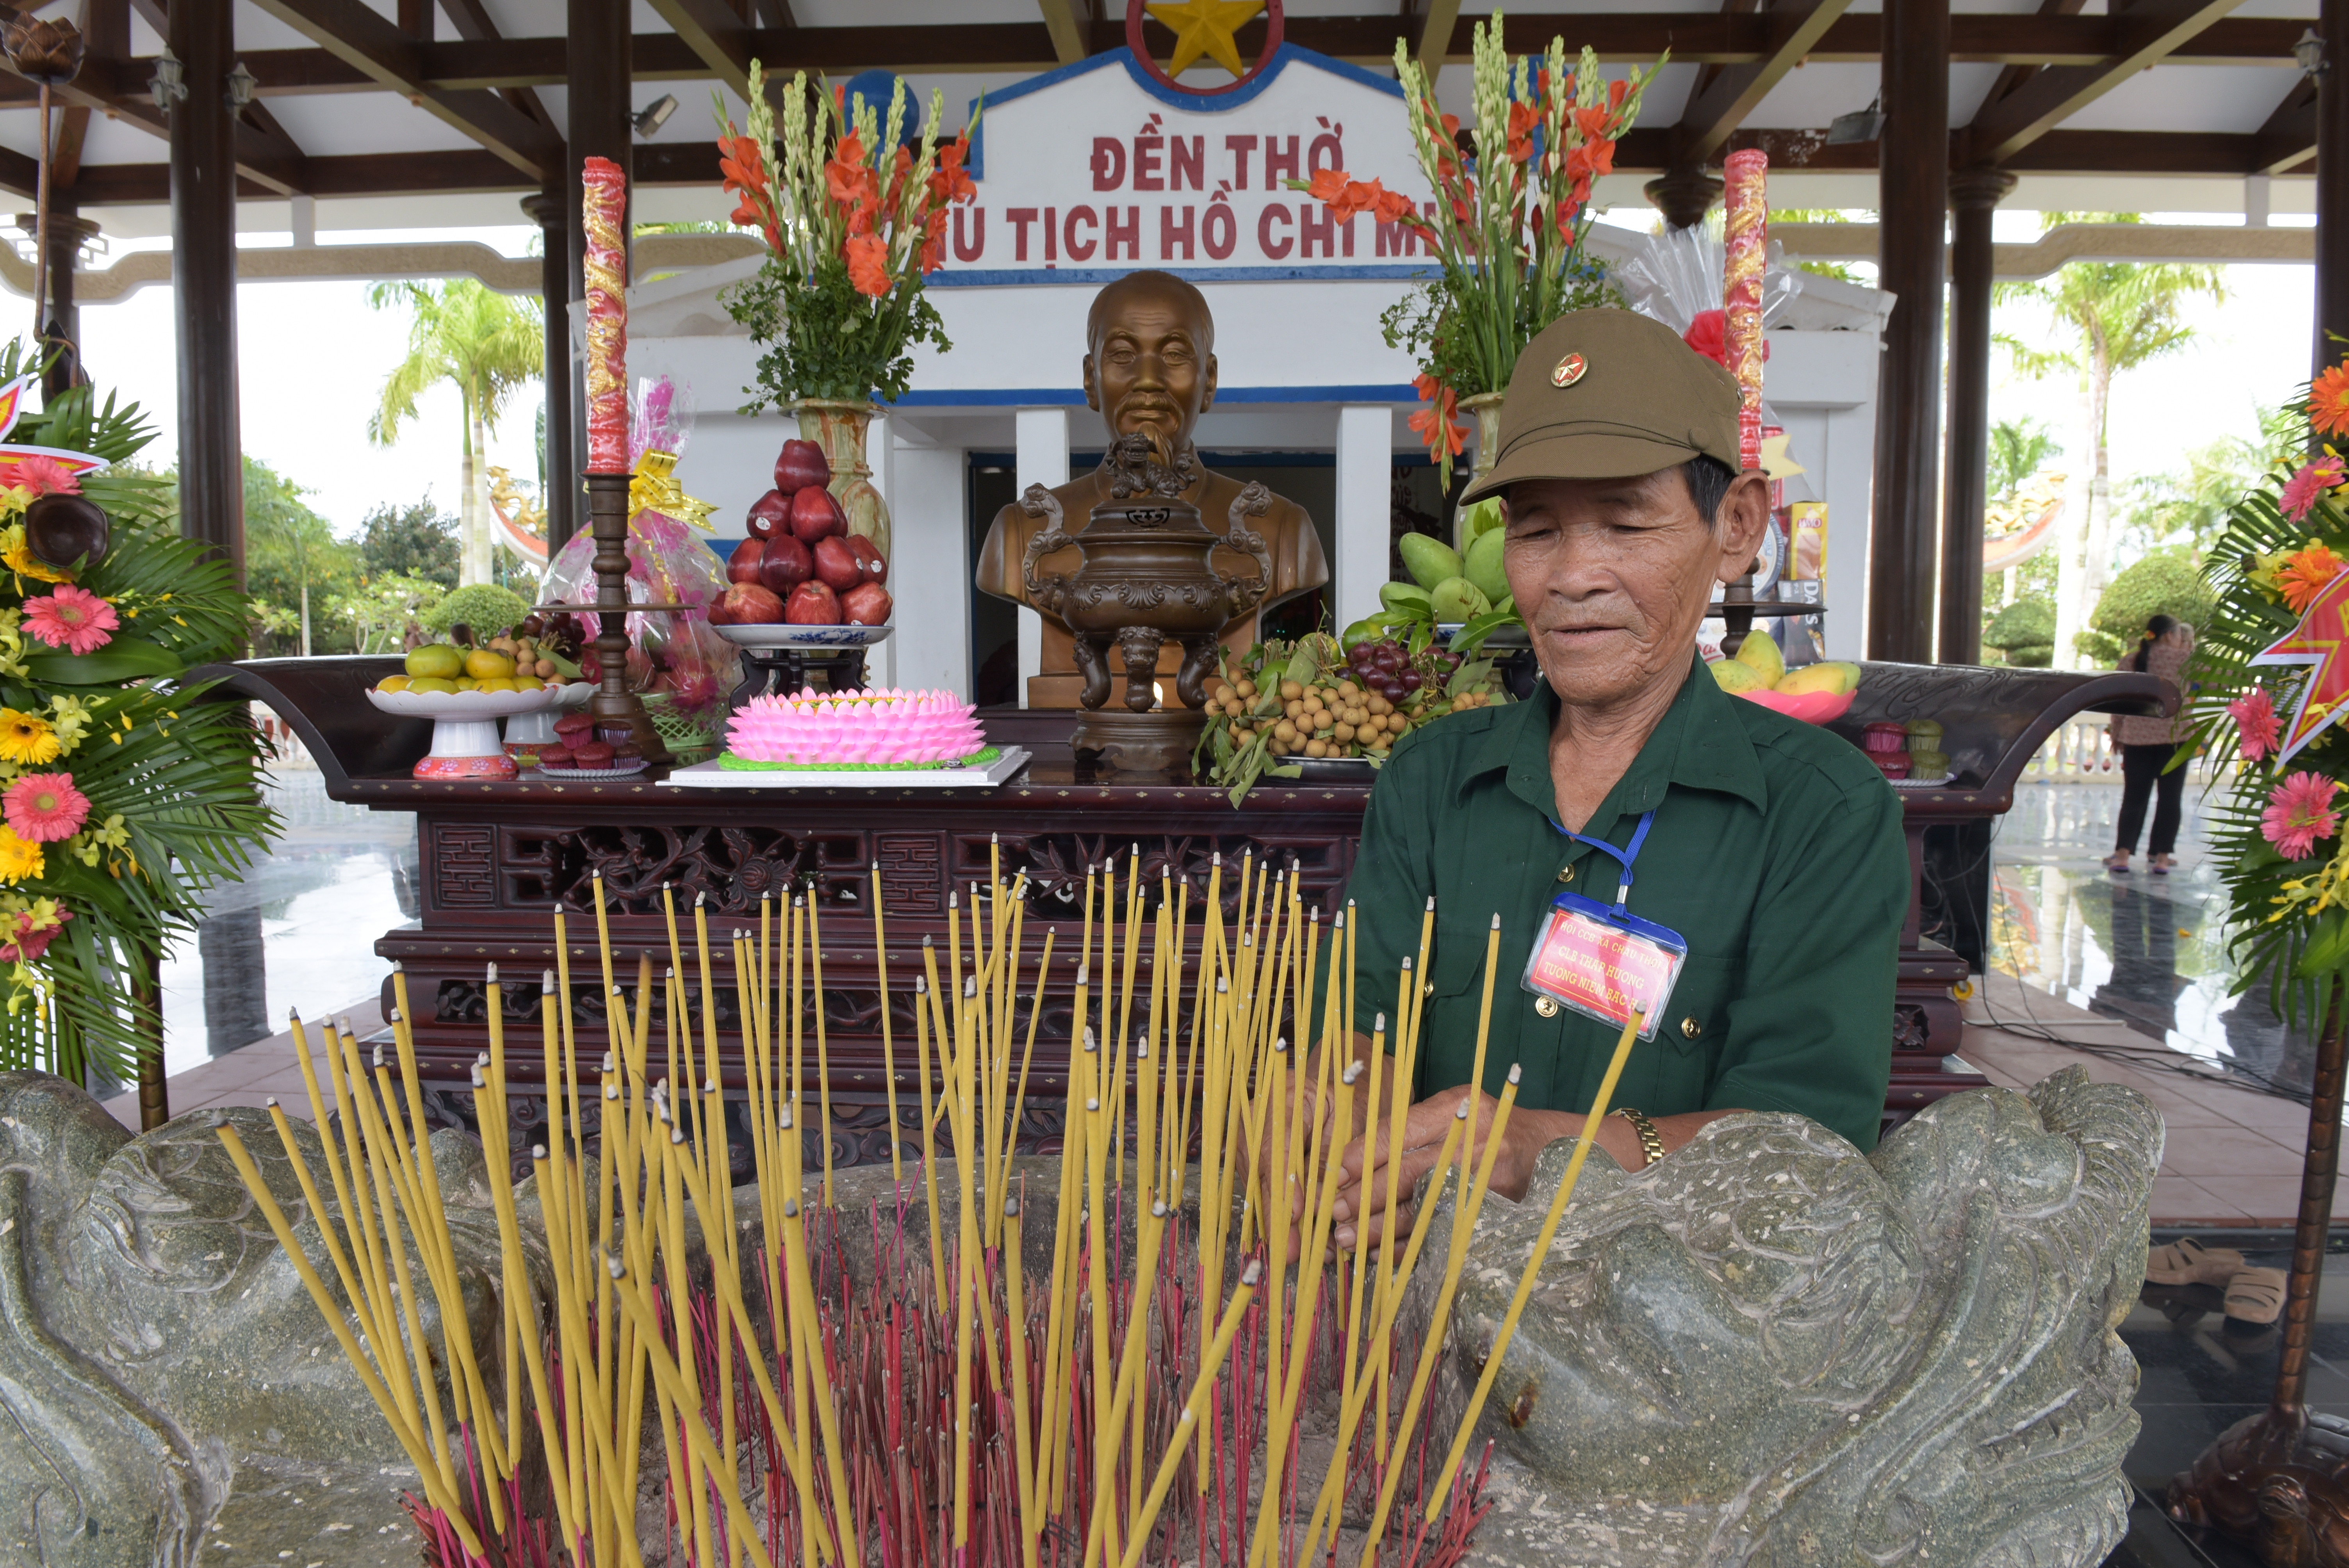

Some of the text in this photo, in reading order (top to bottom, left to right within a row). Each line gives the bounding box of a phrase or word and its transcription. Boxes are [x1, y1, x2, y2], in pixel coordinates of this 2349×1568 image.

[1090, 113, 1343, 191] ĐỀN THỜ
[1006, 205, 1139, 269] TỊCH
[1161, 180, 1237, 260] HỒ
[1375, 201, 1522, 257] MI
[1804, 582, 1819, 625] DAS
[1560, 921, 1576, 935] HỘI
[1578, 929, 1595, 943] CCB
[1598, 936, 1609, 948] XÃ
[1612, 943, 1636, 959] CHÂU
[1545, 962, 1577, 985] TƯỞNG
[1578, 975, 1605, 996] NIỆM
[1606, 988, 1628, 1006] BÁC
[1559, 946, 1577, 960] CLB
[1606, 965, 1644, 989] HƯƠNG
